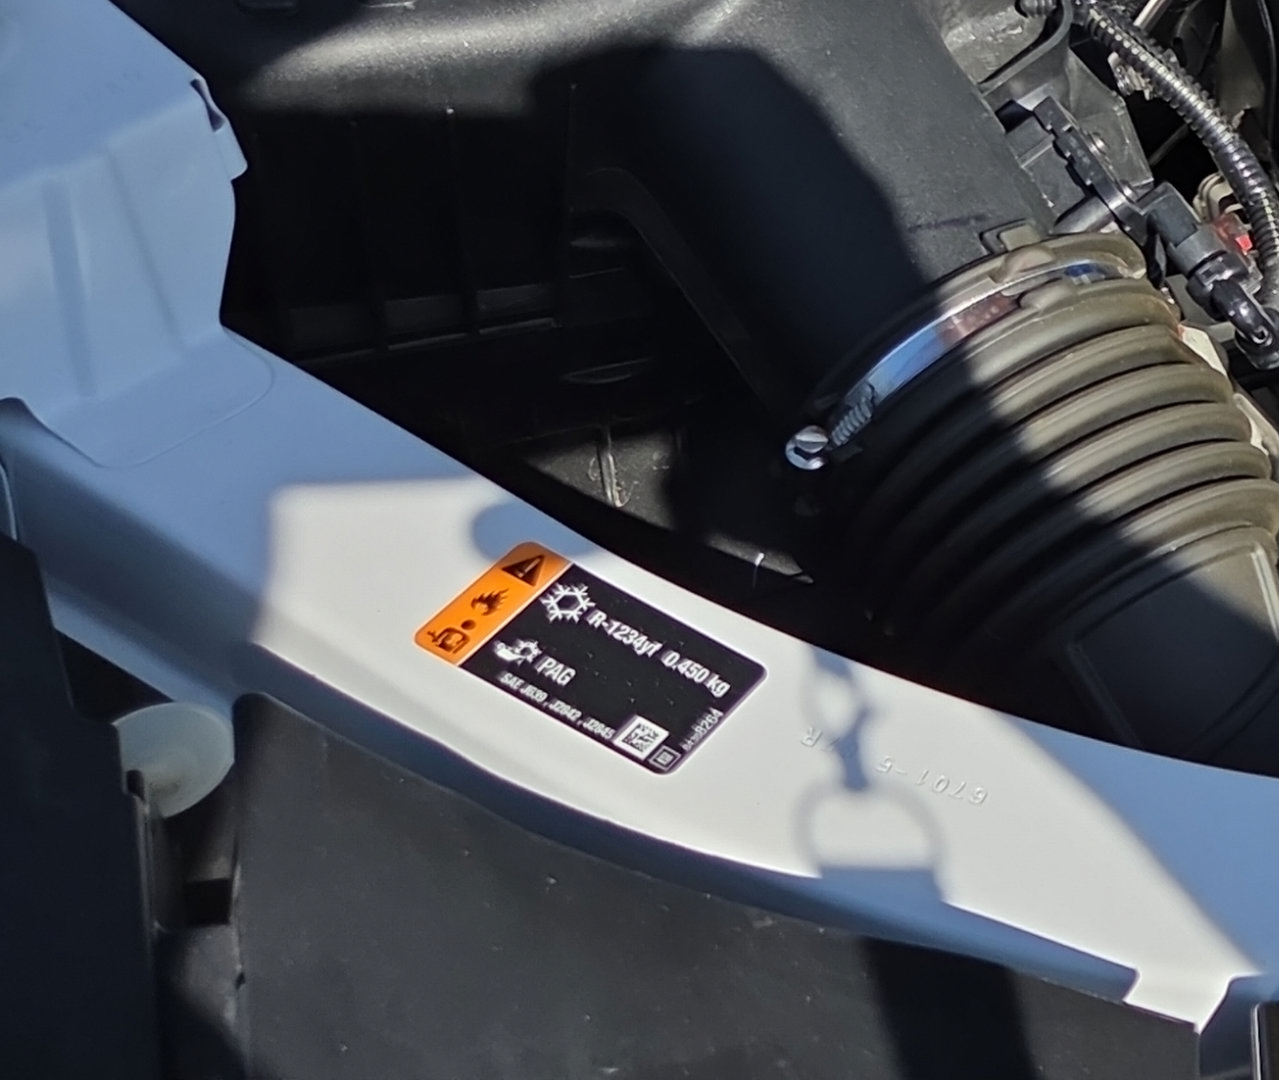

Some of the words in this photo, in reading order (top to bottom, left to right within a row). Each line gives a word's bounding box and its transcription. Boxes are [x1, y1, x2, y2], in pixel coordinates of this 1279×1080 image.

[501, 671, 523, 691] SAE
[536, 655, 577, 687] PAG
[660, 650, 711, 685] 0.450
[705, 673, 732, 699] kg
